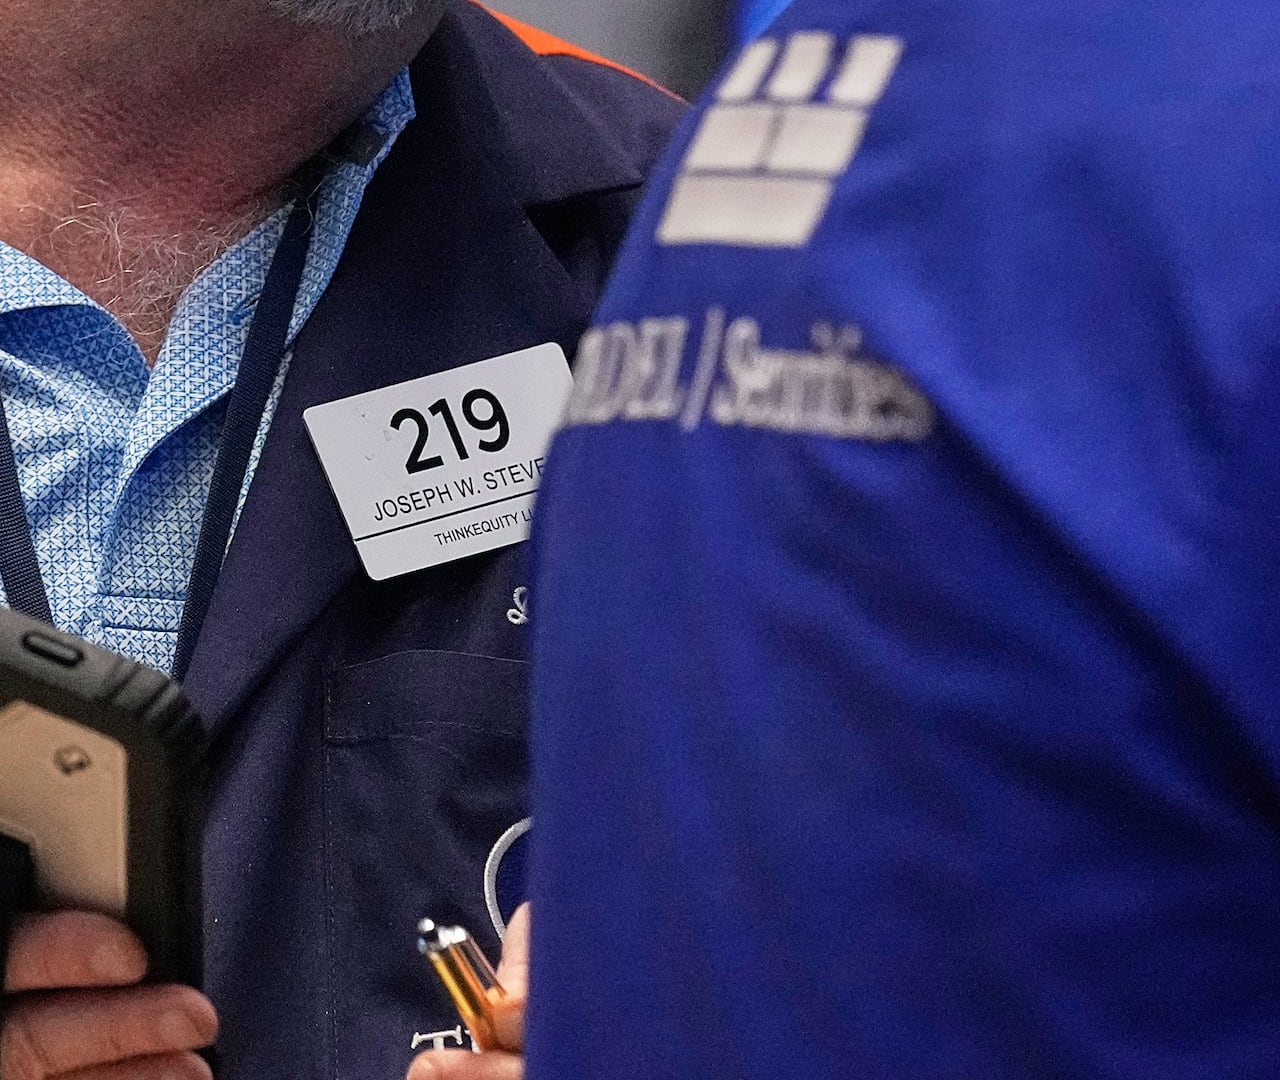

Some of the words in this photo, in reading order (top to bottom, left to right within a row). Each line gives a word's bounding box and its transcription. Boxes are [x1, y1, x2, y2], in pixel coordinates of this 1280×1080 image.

[390, 388, 510, 475] 219
[374, 483, 453, 522] JOSEPH
[454, 477, 481, 499] W.
[434, 512, 519, 546] THINKEQUITY
